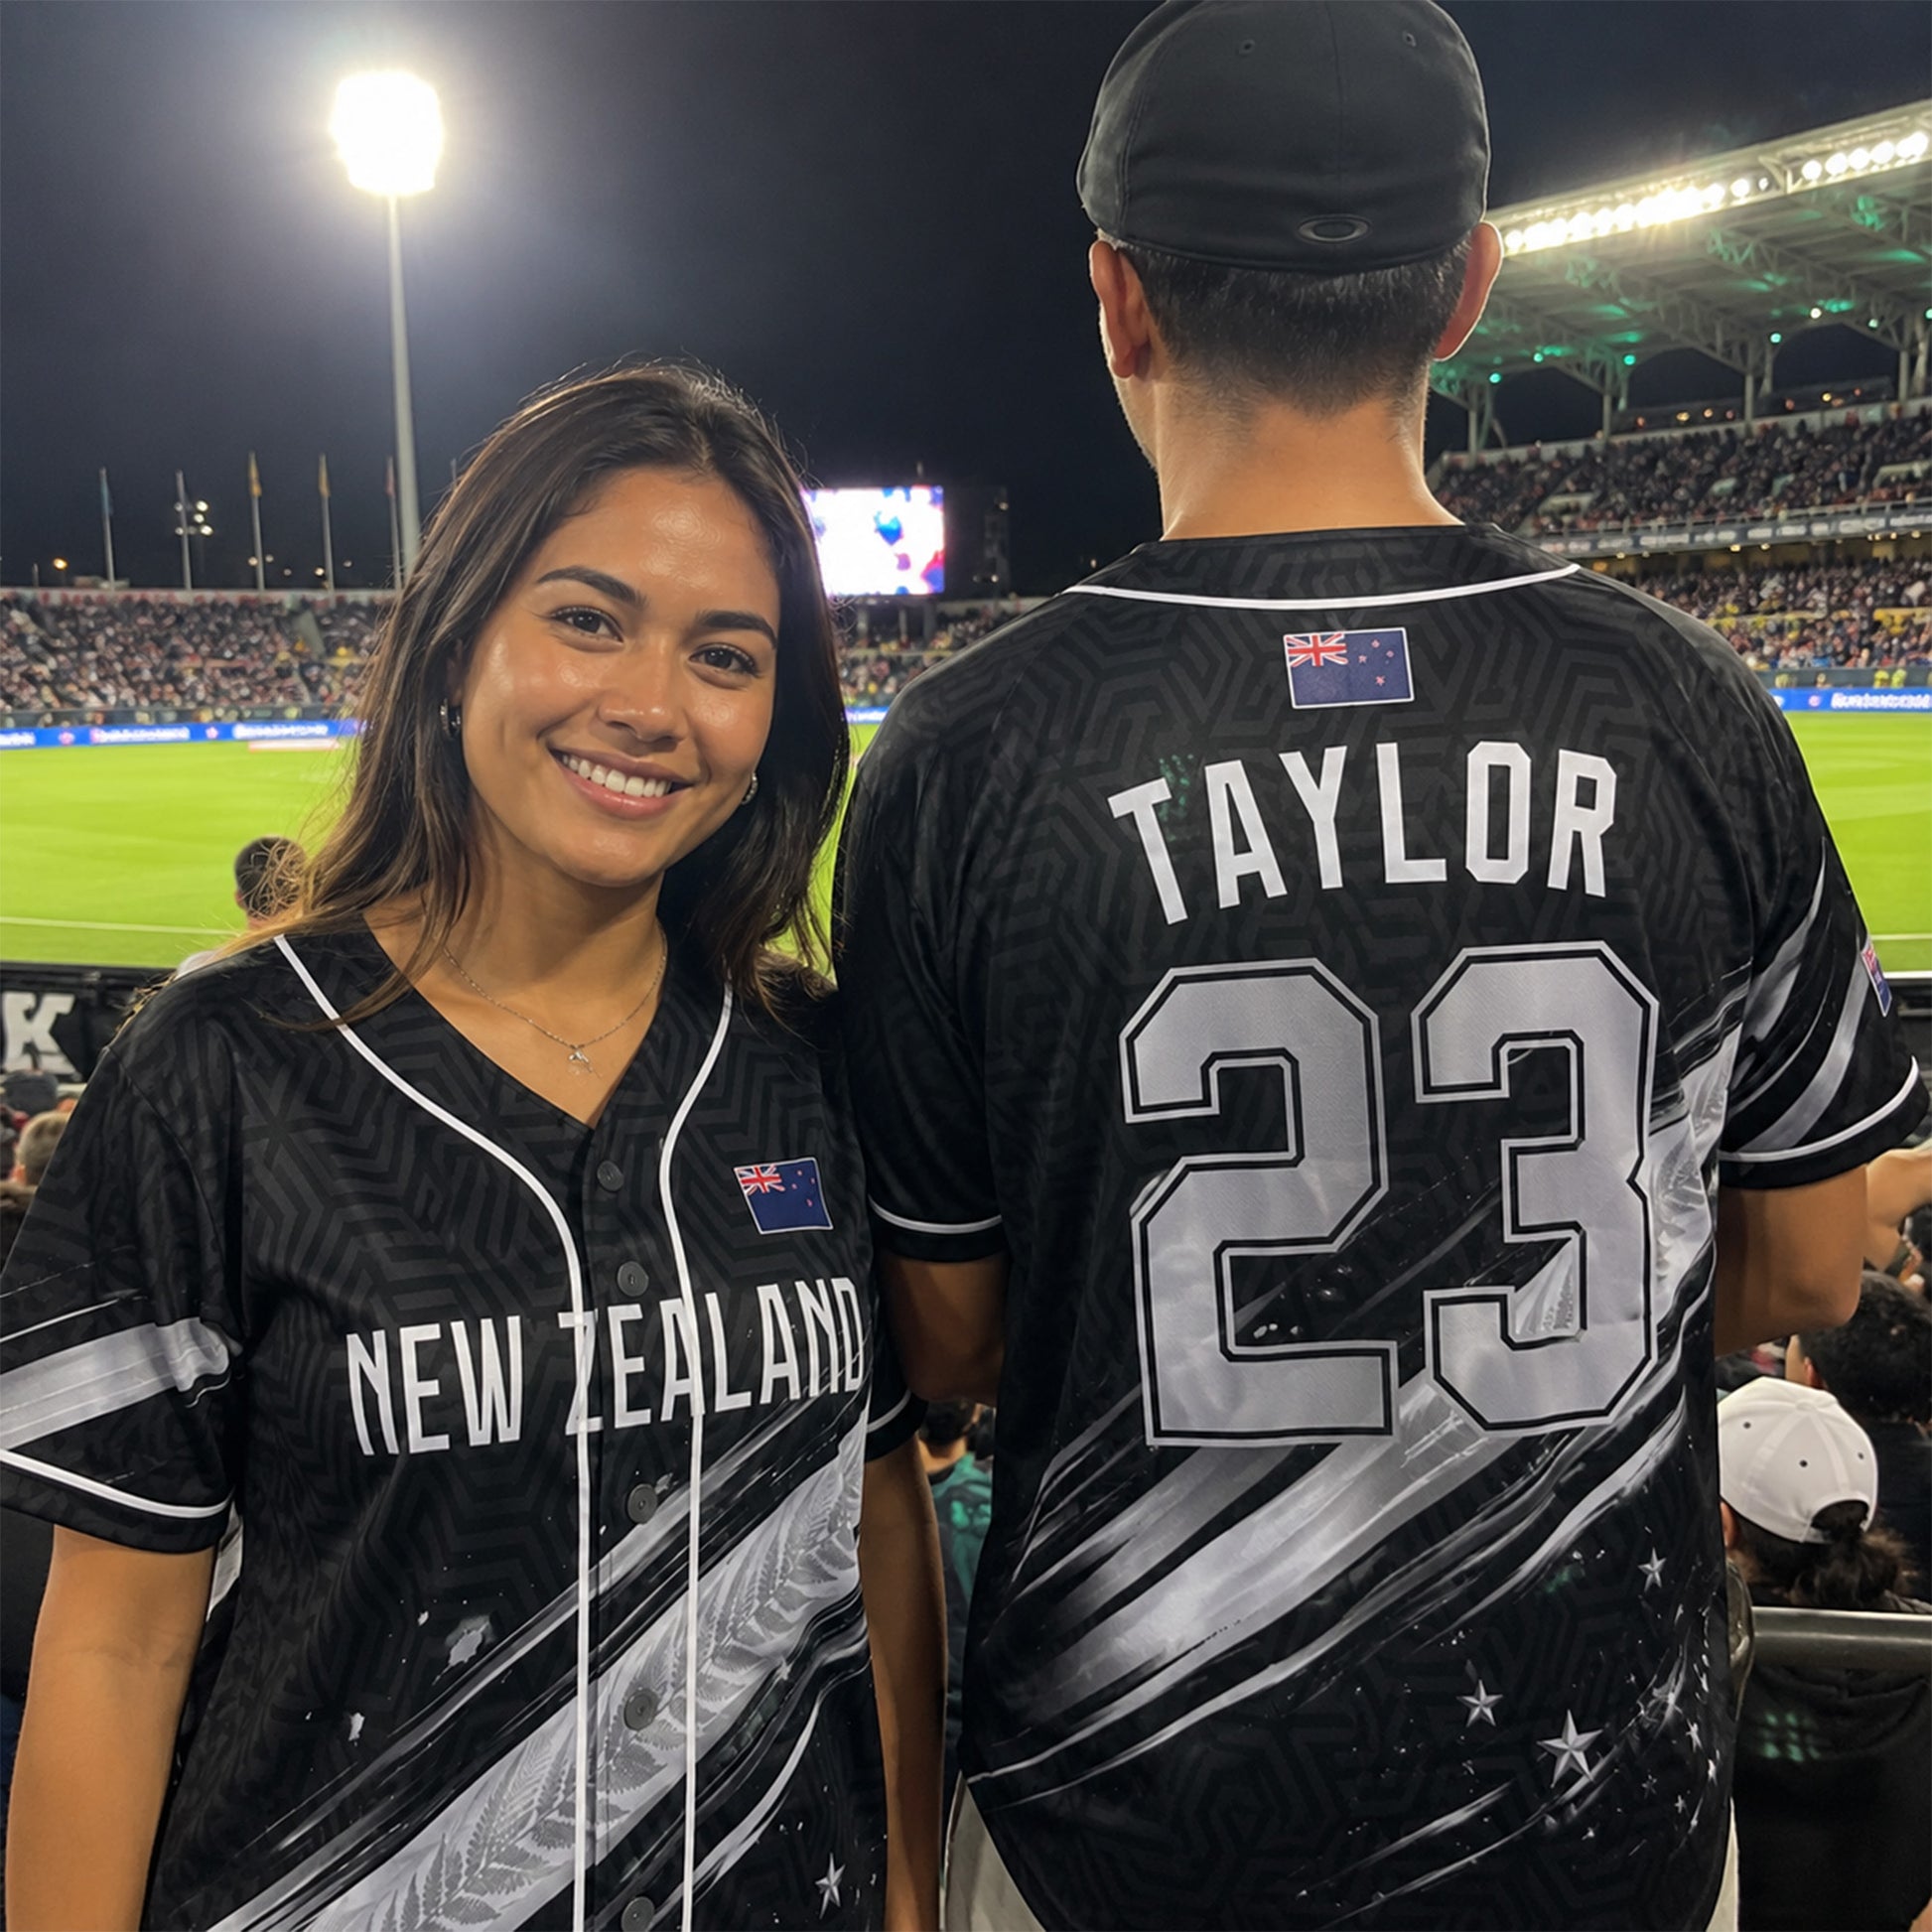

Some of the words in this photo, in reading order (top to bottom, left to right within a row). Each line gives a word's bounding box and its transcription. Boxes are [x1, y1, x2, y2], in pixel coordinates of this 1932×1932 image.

[1107, 740, 1617, 925] TAYLOR
[1118, 939, 1661, 1449] 23
[346, 1314, 523, 1456] NEW
[558, 1276, 867, 1437] ZEALAND
